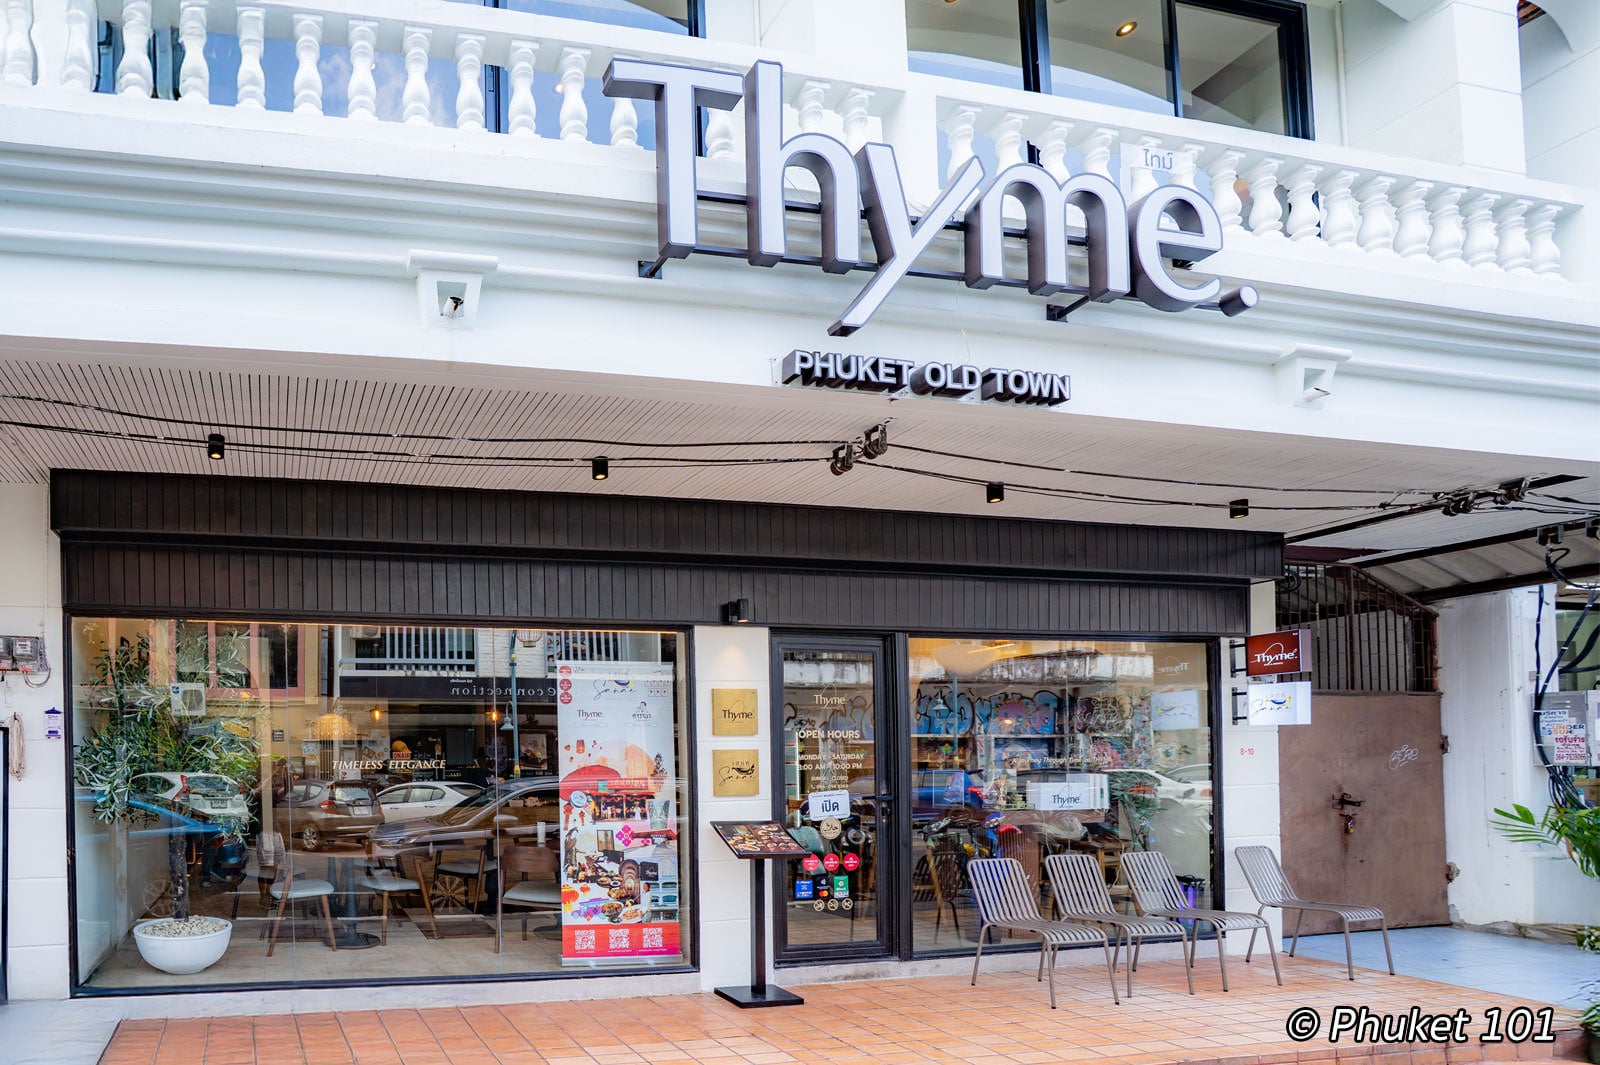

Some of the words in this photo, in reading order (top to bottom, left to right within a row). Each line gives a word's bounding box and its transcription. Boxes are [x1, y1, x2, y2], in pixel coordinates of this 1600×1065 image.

[792, 350, 915, 387] PHUKET
[923, 361, 981, 391] OLD
[987, 367, 1071, 399] TOWN
[798, 730, 825, 738] OPEN
[827, 730, 861, 739] HOURS
[332, 759, 383, 770] TIMELESS
[388, 759, 447, 770] ELEGANCE
[821, 799, 839, 813] เปิด
